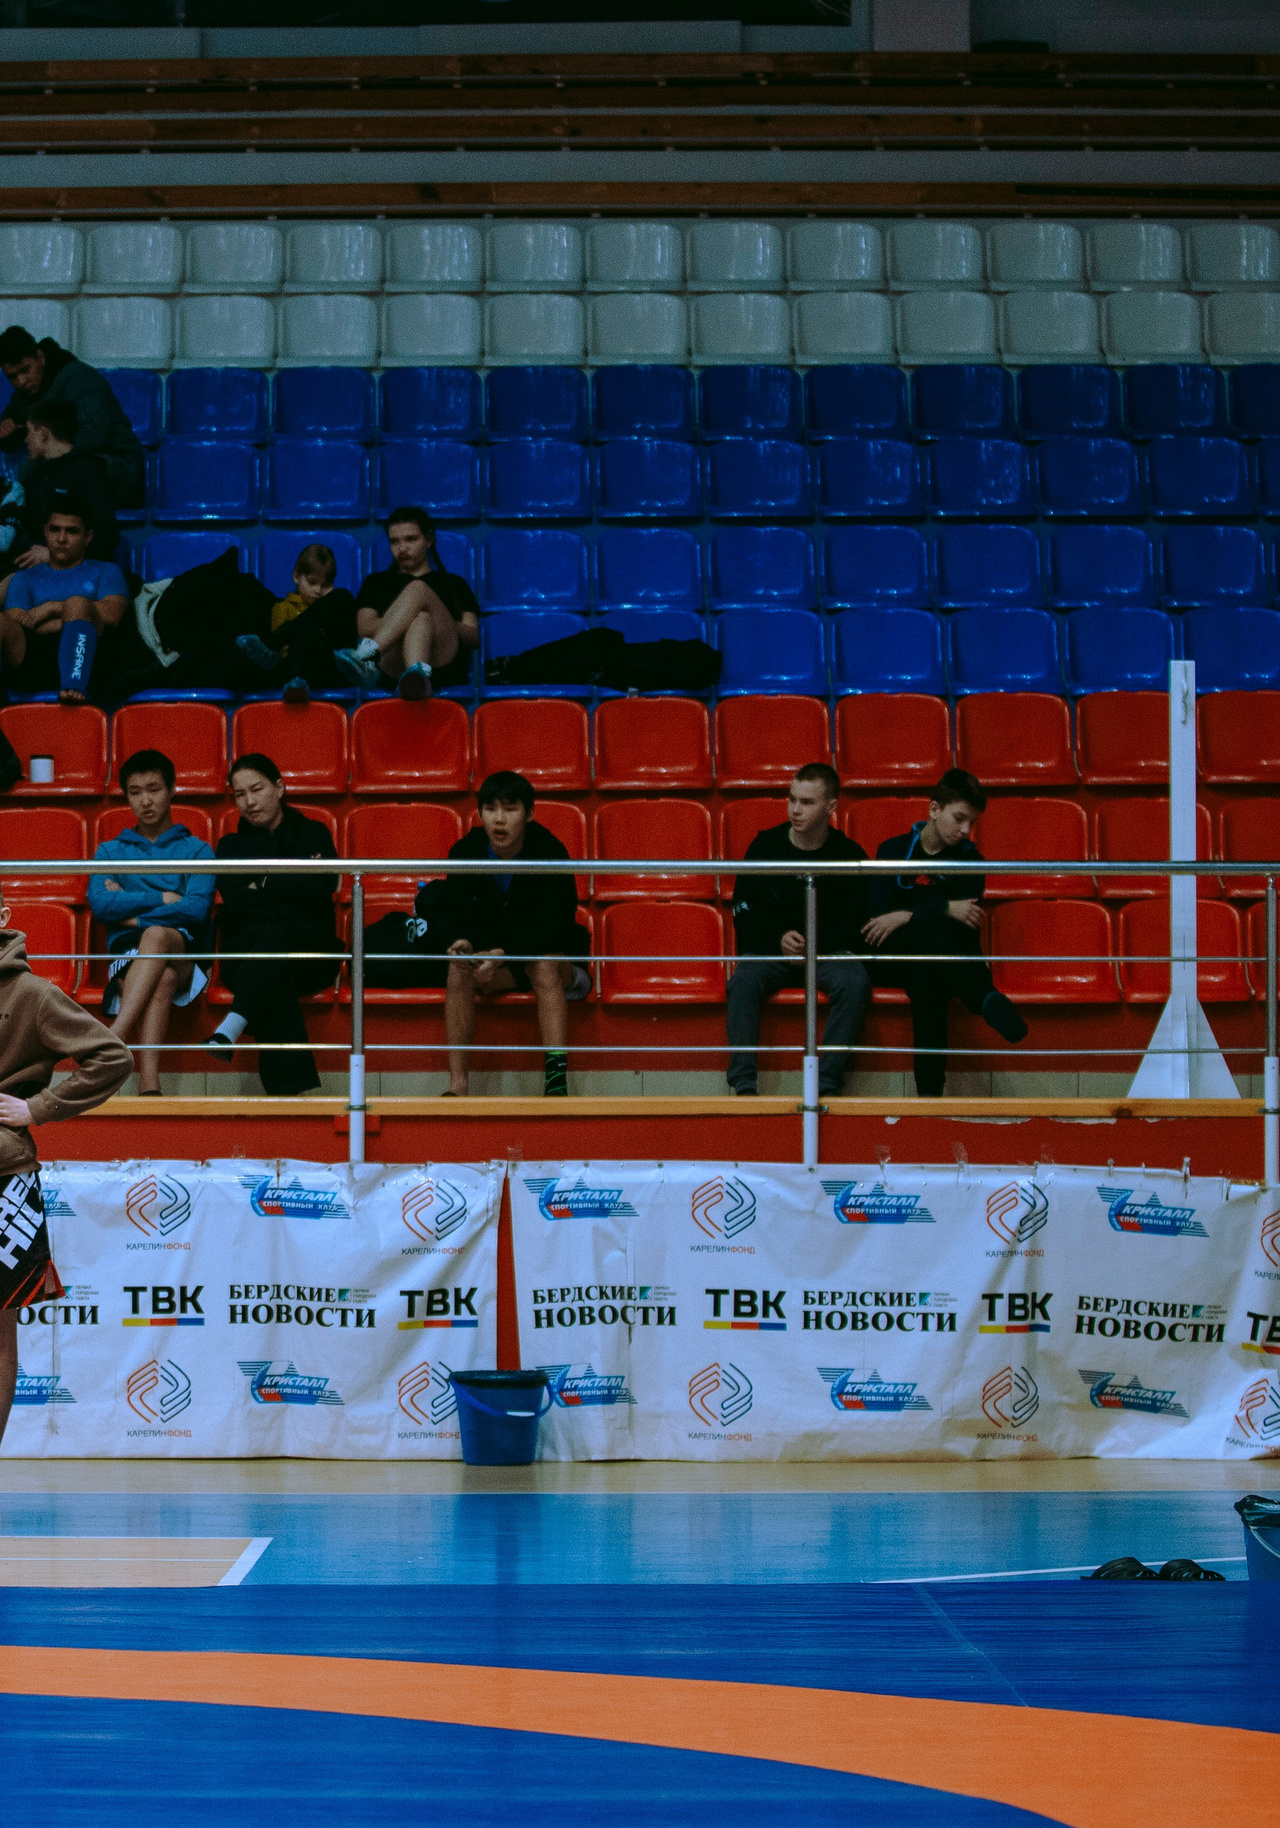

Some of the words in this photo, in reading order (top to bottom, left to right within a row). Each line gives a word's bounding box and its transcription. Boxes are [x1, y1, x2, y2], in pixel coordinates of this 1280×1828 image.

[264, 1190, 334, 1202] КРИСТАЛЛ
[552, 1190, 618, 1202] КРИСТАЛЛ
[849, 1195, 916, 1206] КРИСТАЛЛ
[1122, 1205, 1192, 1219] КРИСТАЛЛ
[124, 1286, 204, 1314] ТВК
[229, 1285, 336, 1302] БЕРДСКИЕ
[532, 1286, 637, 1304] БЕРДСКИЕ
[803, 1291, 916, 1308] БЕРДСКИЕ
[400, 1288, 478, 1318] ТВК
[705, 1289, 786, 1319] ТВК
[982, 1293, 1052, 1321] ТВК
[1078, 1296, 1190, 1319] БЕРДСКИЕ
[229, 1304, 376, 1328] НОВОСТИ
[534, 1305, 676, 1329] НОВОСТИ
[803, 1311, 957, 1332] НОВОСТИ
[1075, 1316, 1225, 1343] НОВОСТИ
[1247, 1311, 1280, 1342] ТВ
[16, 1377, 57, 1387] СТАЛЛ
[264, 1377, 325, 1388] КРИСТАЛЛ
[564, 1378, 622, 1389] КРИСТАЛЛ
[844, 1382, 912, 1393] КРИСТАЛЛ
[1103, 1386, 1172, 1401] КРИСТАЛЛ
